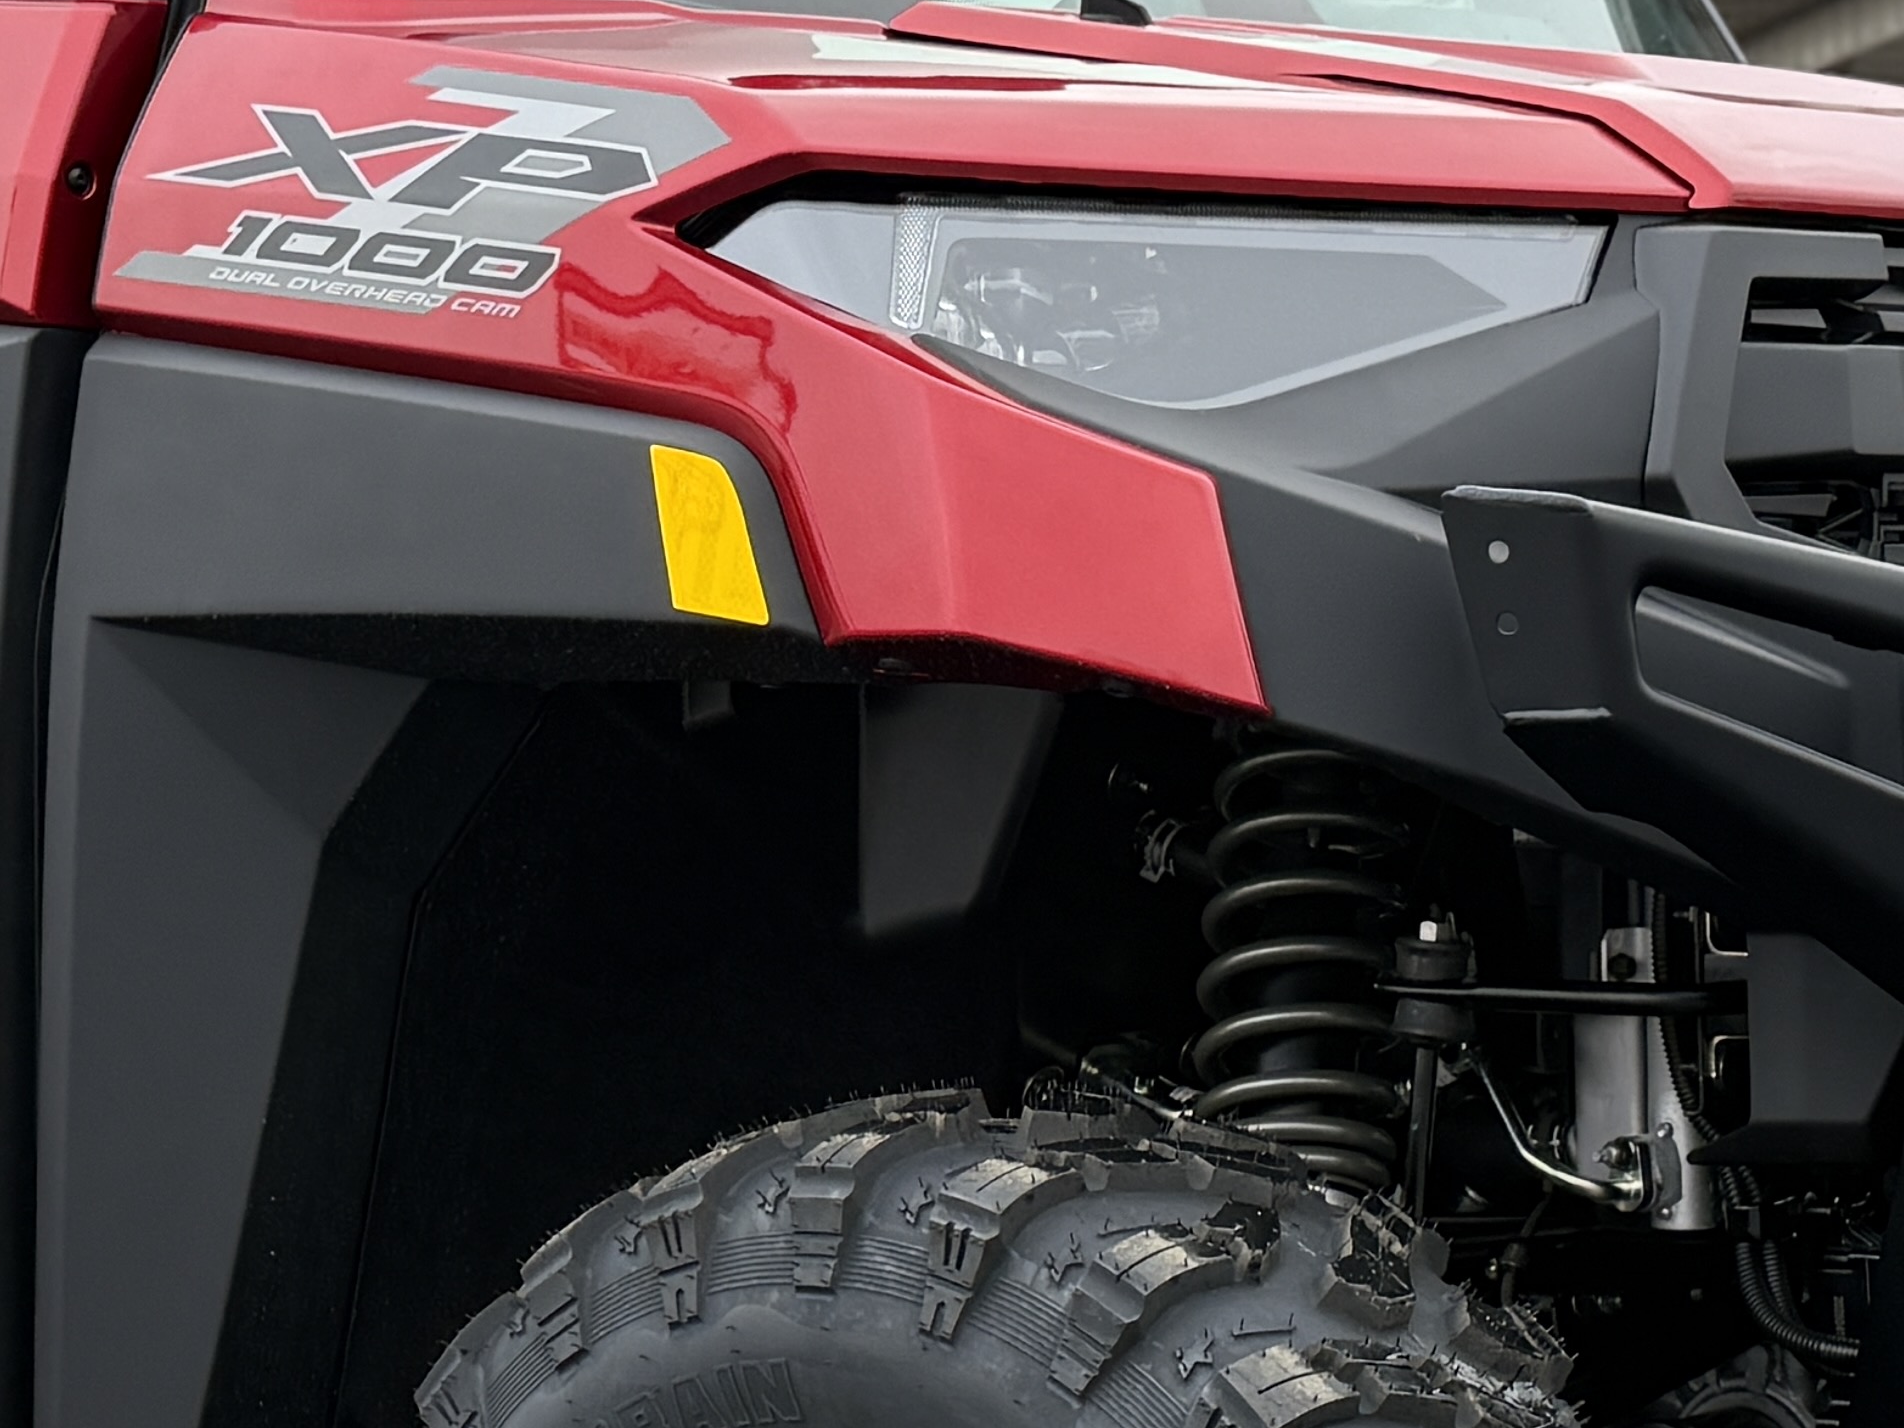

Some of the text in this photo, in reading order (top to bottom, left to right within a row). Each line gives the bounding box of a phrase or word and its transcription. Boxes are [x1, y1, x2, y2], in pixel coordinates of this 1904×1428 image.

[143, 103, 657, 211] XP
[208, 265, 522, 319] DUAL OVERHEAD CAM
[219, 211, 562, 297] 1000
